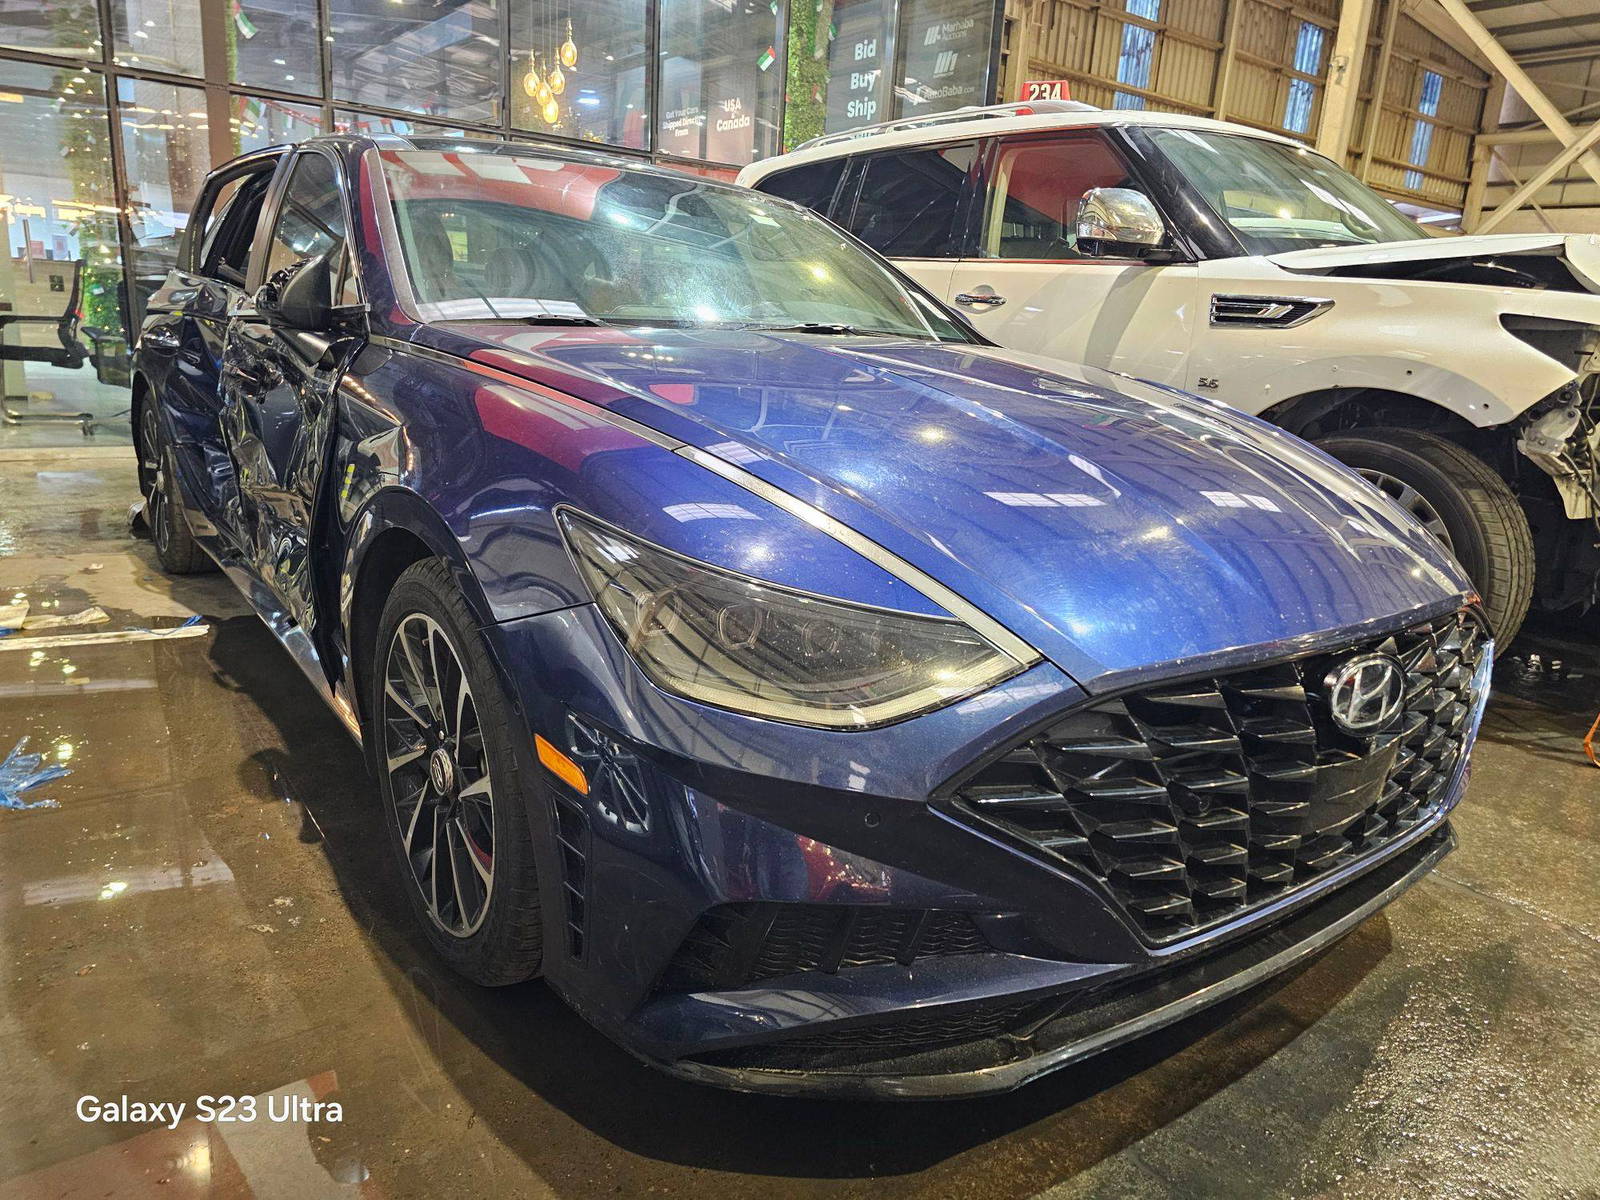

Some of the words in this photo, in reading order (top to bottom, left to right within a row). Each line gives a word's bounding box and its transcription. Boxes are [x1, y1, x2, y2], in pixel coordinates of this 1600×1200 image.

[854, 39, 877, 60] Bid
[850, 72, 876, 92] Buy
[1030, 83, 1061, 100] 234
[724, 98, 741, 112] USA
[847, 97, 877, 120] Ship
[716, 114, 750, 131] Canada
